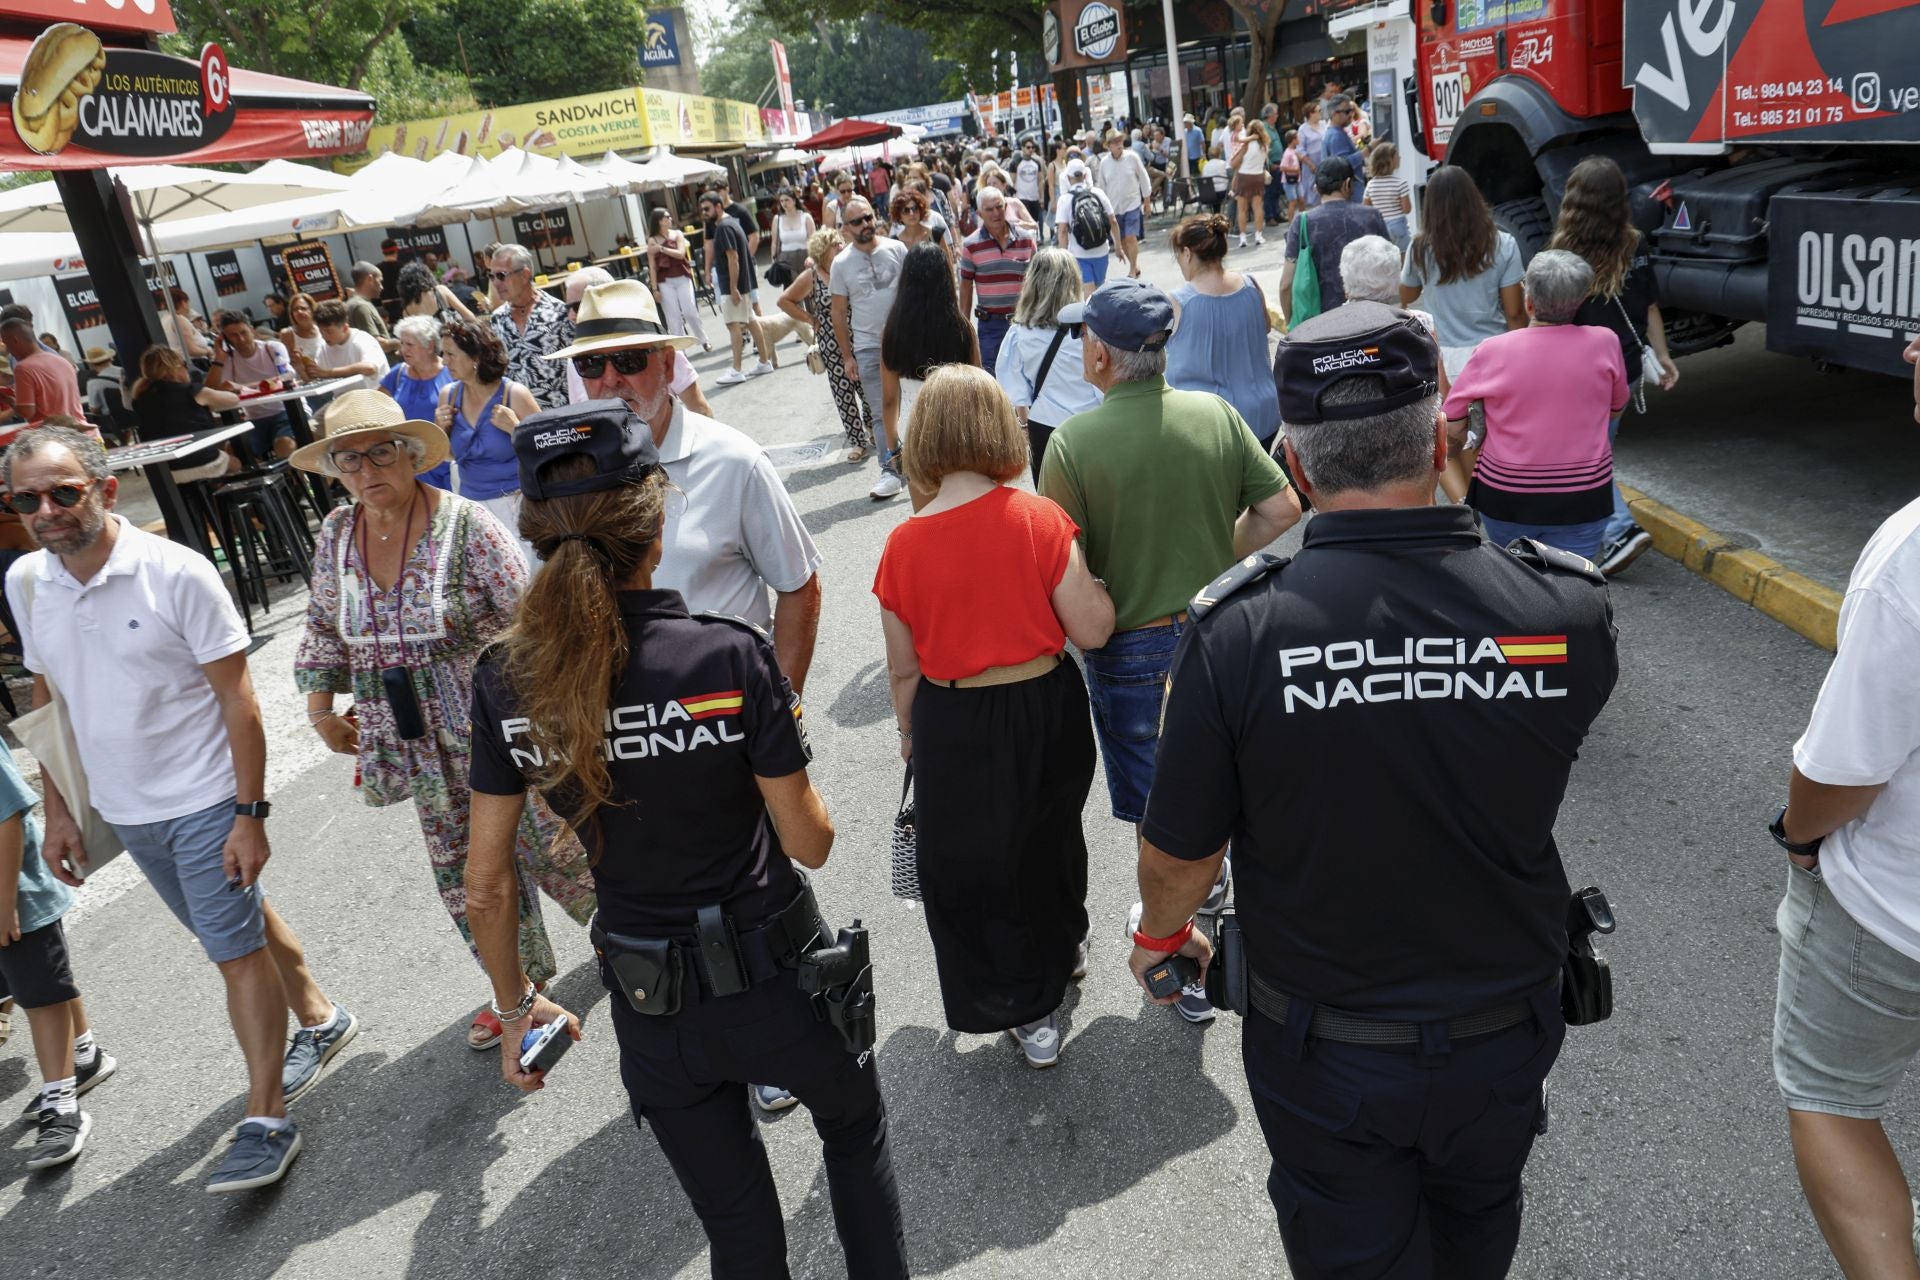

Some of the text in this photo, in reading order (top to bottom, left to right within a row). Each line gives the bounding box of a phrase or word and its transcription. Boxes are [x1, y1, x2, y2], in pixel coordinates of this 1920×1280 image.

[1080, 28, 1090, 41] El
[1090, 20, 1115, 36] Globo
[106, 73, 199, 96] LOS AUTÉNTICOS
[1760, 83, 1784, 99] 984
[1787, 81, 1803, 97] 04
[1806, 79, 1824, 95] 23
[1827, 77, 1843, 94] 14
[1435, 79, 1463, 119] 902
[79, 94, 203, 137] CALAMARES
[536, 97, 637, 126] SANDWICH
[1760, 109, 1783, 125] 985
[1786, 109, 1801, 124] 21
[1805, 108, 1821, 123] 01
[1826, 106, 1843, 122] 75
[300, 120, 341, 149] DESDE
[557, 117, 640, 139] COSTA VERDE
[518, 221, 531, 233] EL
[211, 262, 239, 277] EL CHILU
[290, 255, 326, 268] TERRAZA
[304, 268, 330, 281] CHILU
[66, 293, 78, 308] EL
[78, 289, 99, 305] CHIL
[1797, 306, 1920, 331] IMPRESIÓN Y RECURSOS GRÁFICO
[1314, 354, 1380, 375] NACIONAL
[535, 433, 592, 450] NACIONAL
[1283, 670, 1568, 713] NACIONAL
